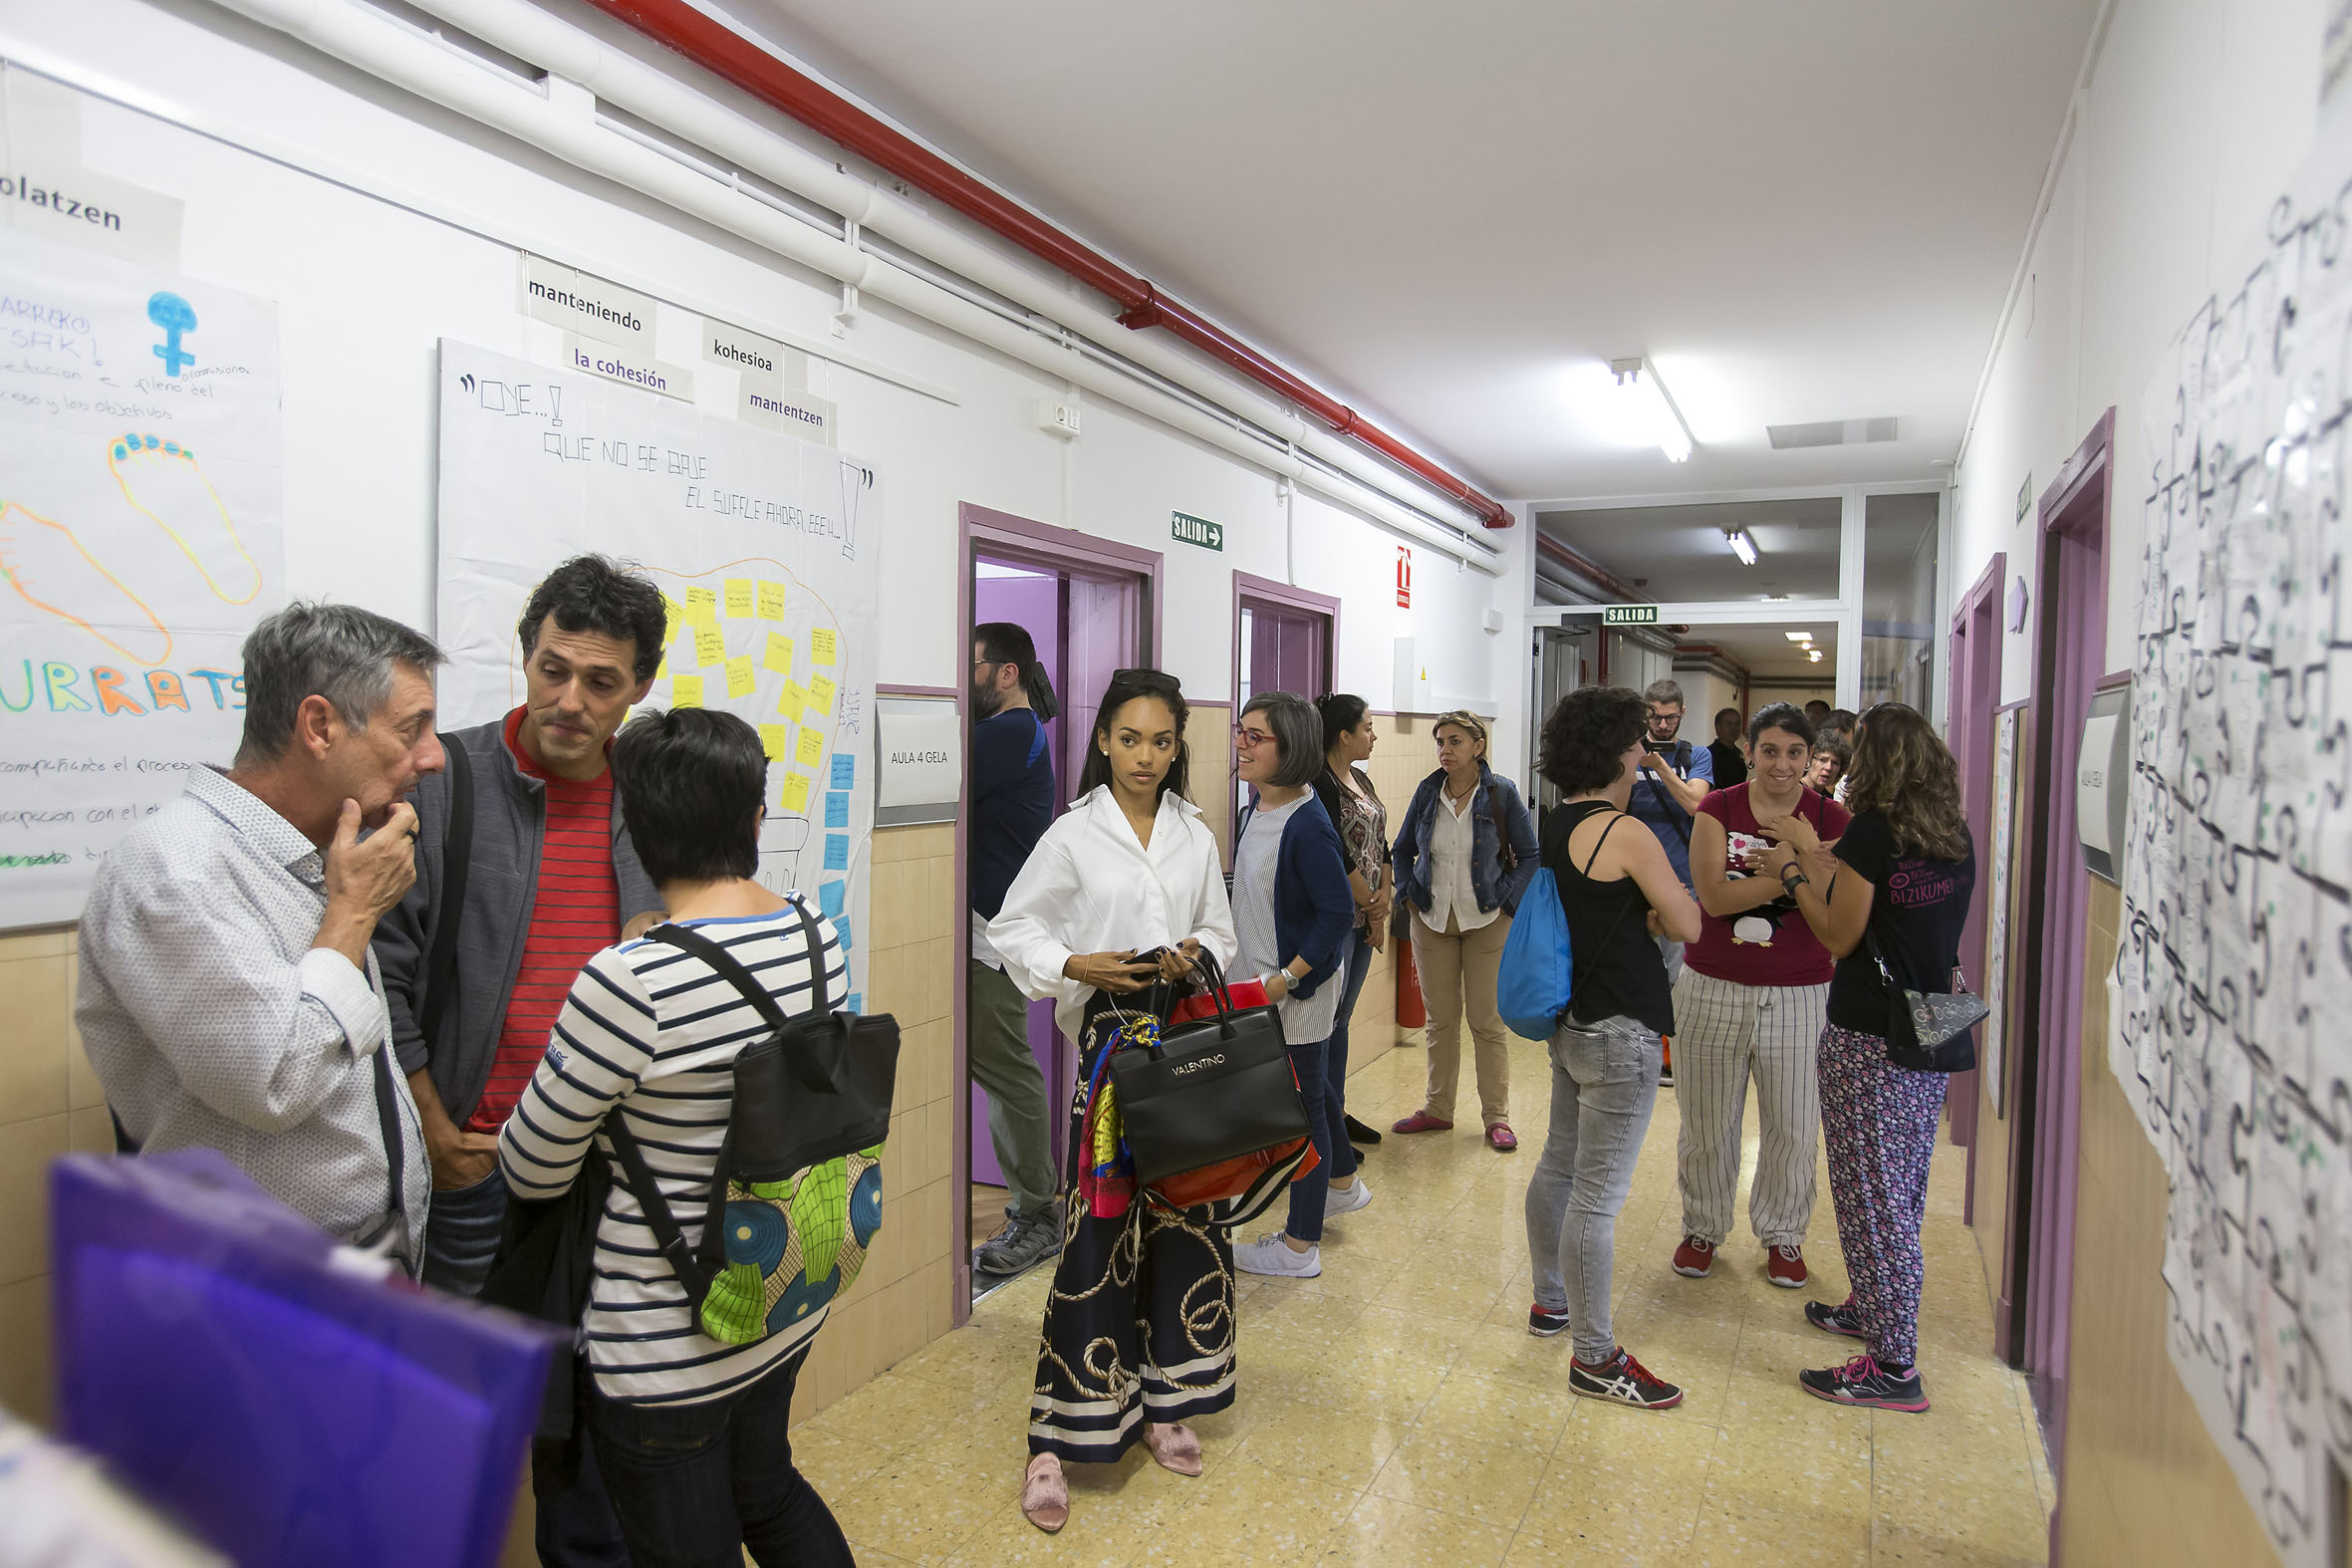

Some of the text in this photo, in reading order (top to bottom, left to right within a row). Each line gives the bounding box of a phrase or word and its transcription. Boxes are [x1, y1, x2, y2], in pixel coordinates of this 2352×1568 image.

[528, 278, 642, 332] manteniendo
[713, 340, 773, 373] kohesioa
[574, 349, 667, 392] la cohesión
[749, 392, 825, 427] mantentzen
[543, 431, 707, 480] QUE NO SE BAJE
[685, 486, 705, 509] EL
[1174, 515, 1208, 544] SALIDA
[1609, 608, 1654, 622] SALIDA
[114, 755, 129, 772] el
[891, 751, 948, 765] AULA 4 GELA
[121, 802, 137, 820] el
[1172, 1053, 1225, 1077] VALENTINO
